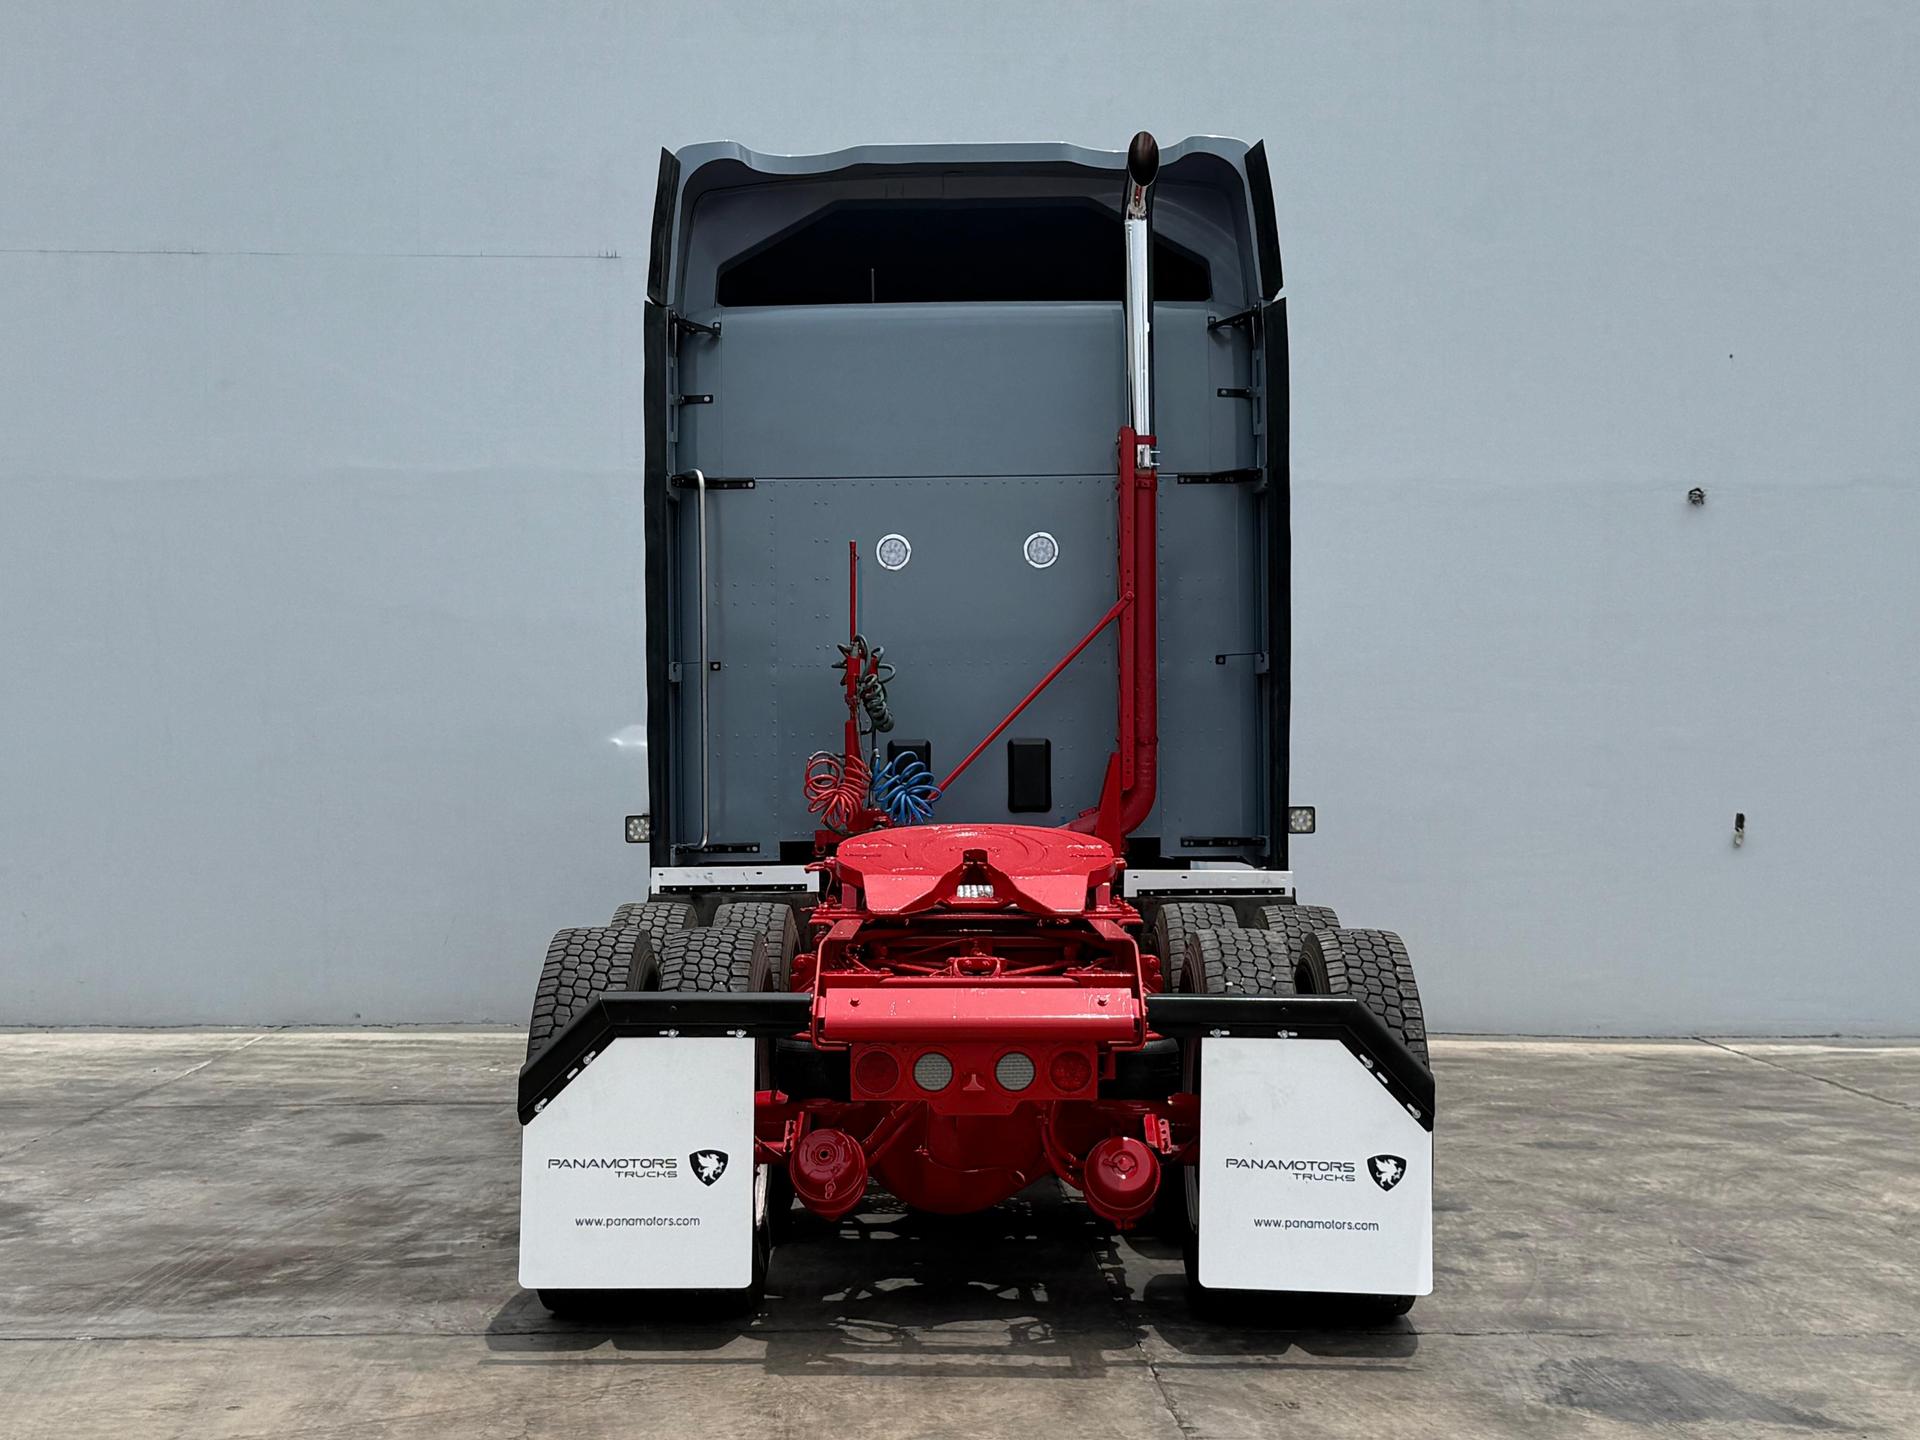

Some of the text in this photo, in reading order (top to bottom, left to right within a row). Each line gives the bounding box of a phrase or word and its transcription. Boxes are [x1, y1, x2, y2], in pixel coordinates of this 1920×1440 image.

[547, 1158, 678, 1169] PANAMOTORS
[1225, 1158, 1356, 1173] PANAMOTORS
[614, 1170, 678, 1179] TRUCKS
[1292, 1172, 1356, 1182] TRUCKS
[575, 1216, 701, 1229] www.panamotors.com
[1253, 1218, 1379, 1231] www.panamotors.com
